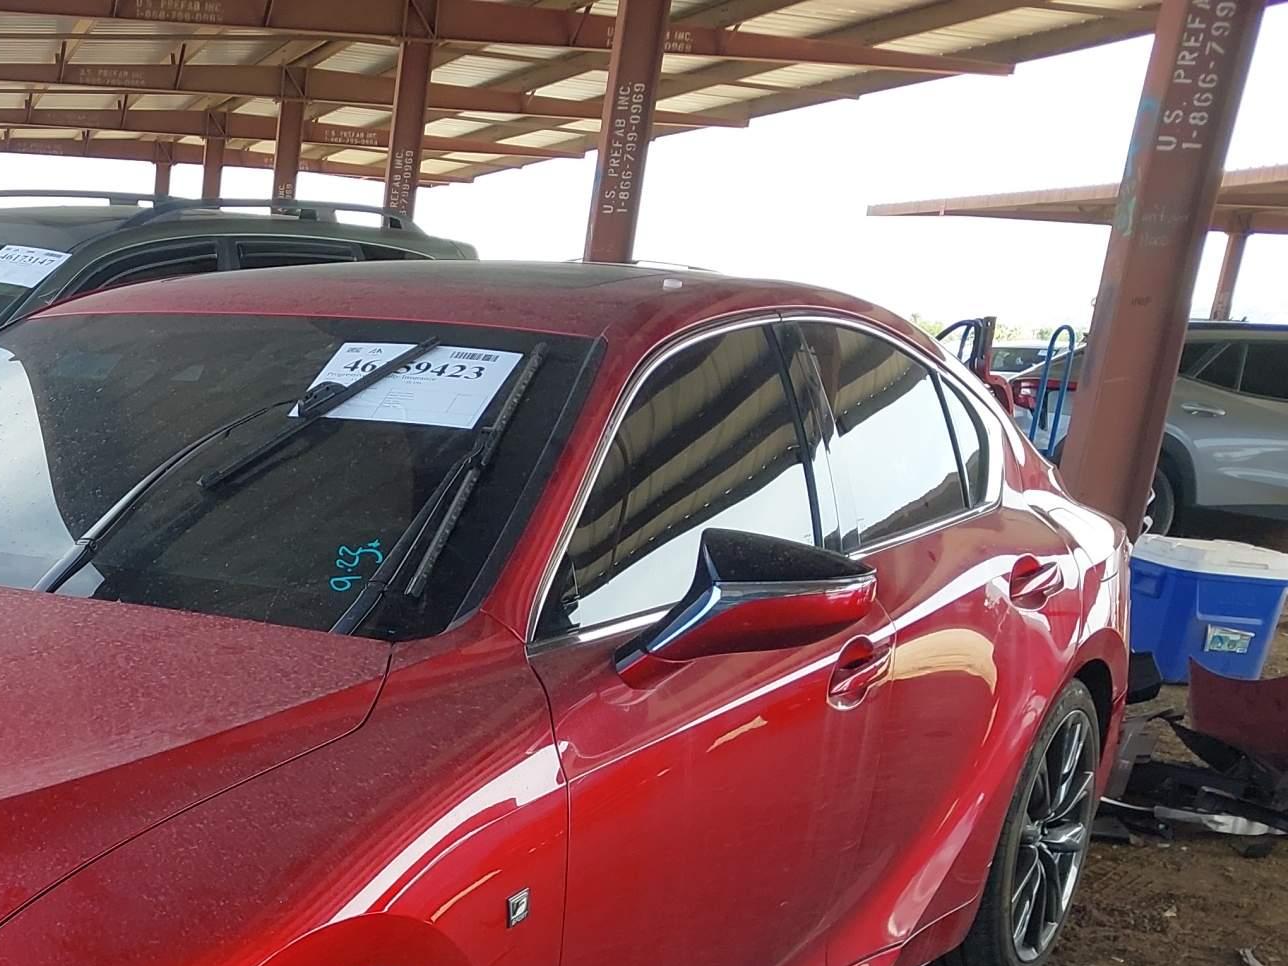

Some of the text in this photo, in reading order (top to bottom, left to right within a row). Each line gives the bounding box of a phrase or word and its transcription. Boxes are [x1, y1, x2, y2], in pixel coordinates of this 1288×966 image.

[608, 118, 626, 177] PREFAB
[617, 83, 646, 213] 1-866-799-0969
[343, 358, 486, 380] 4659423
